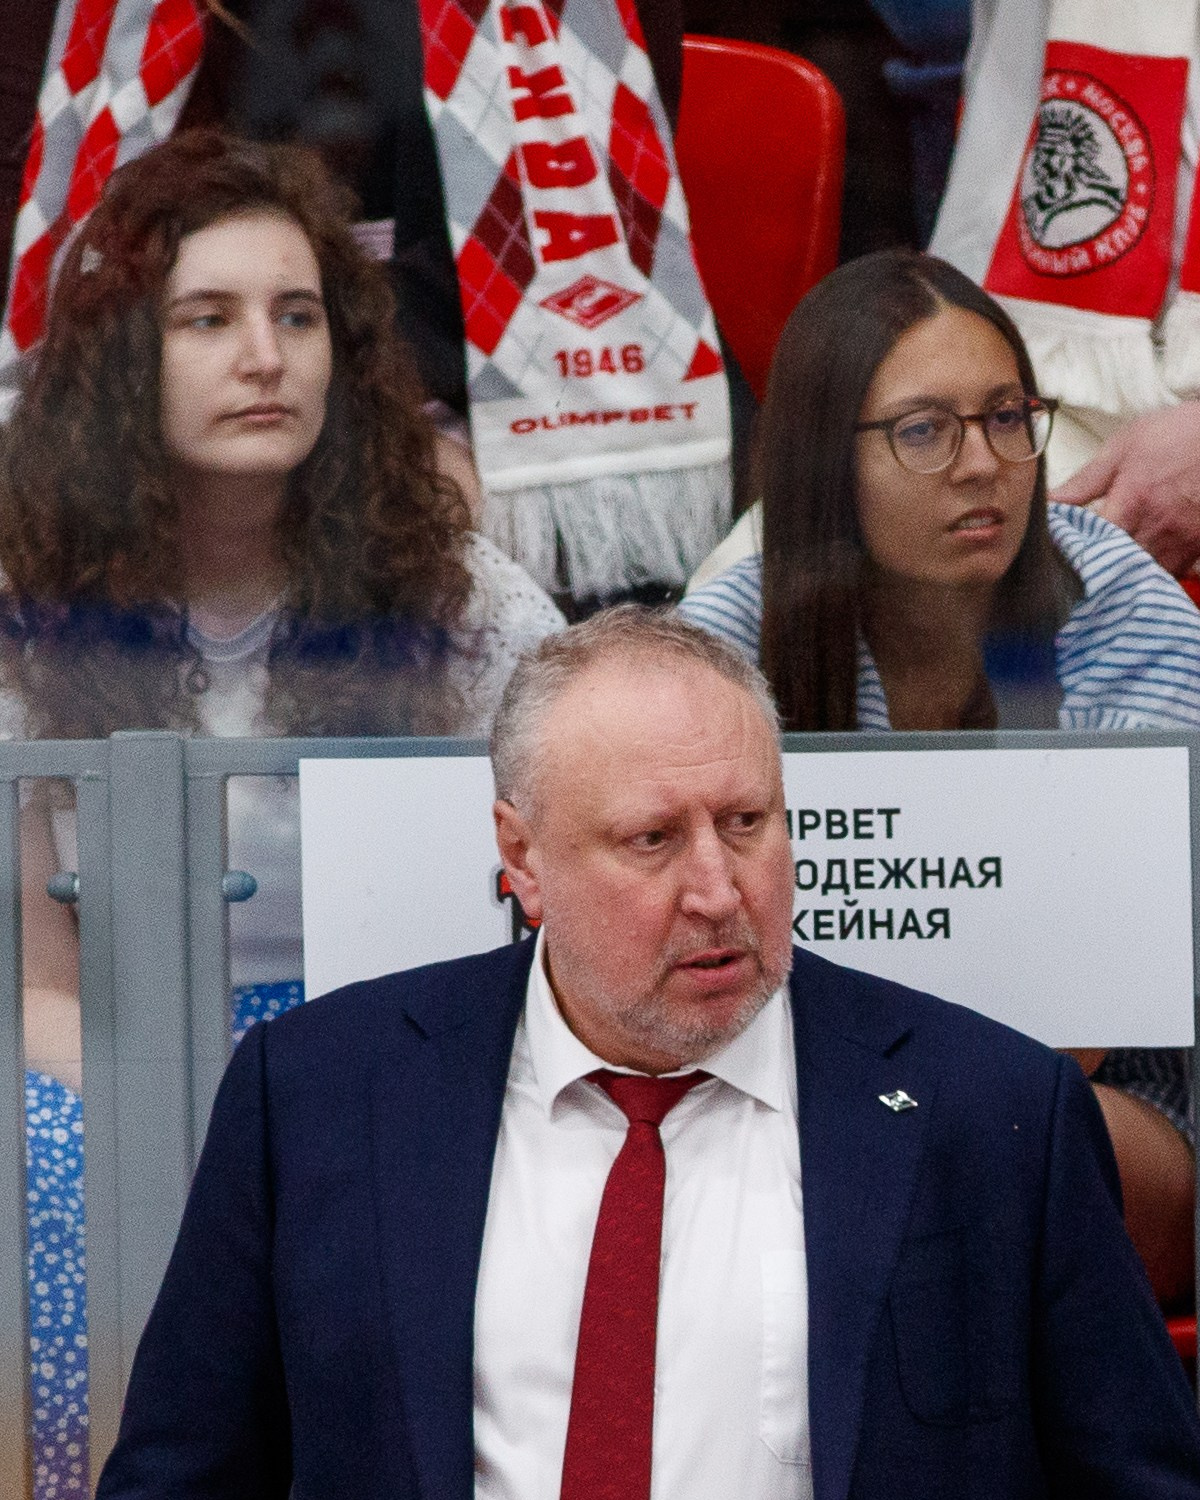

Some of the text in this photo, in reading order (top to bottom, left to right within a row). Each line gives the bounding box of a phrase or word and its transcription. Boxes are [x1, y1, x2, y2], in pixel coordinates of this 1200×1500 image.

[553, 344, 645, 378] 1946
[509, 401, 699, 435] OLIMPBET
[794, 855, 1003, 896] ОДЕЖНАЯ
[792, 898, 951, 941] КЕЙНАЯ
